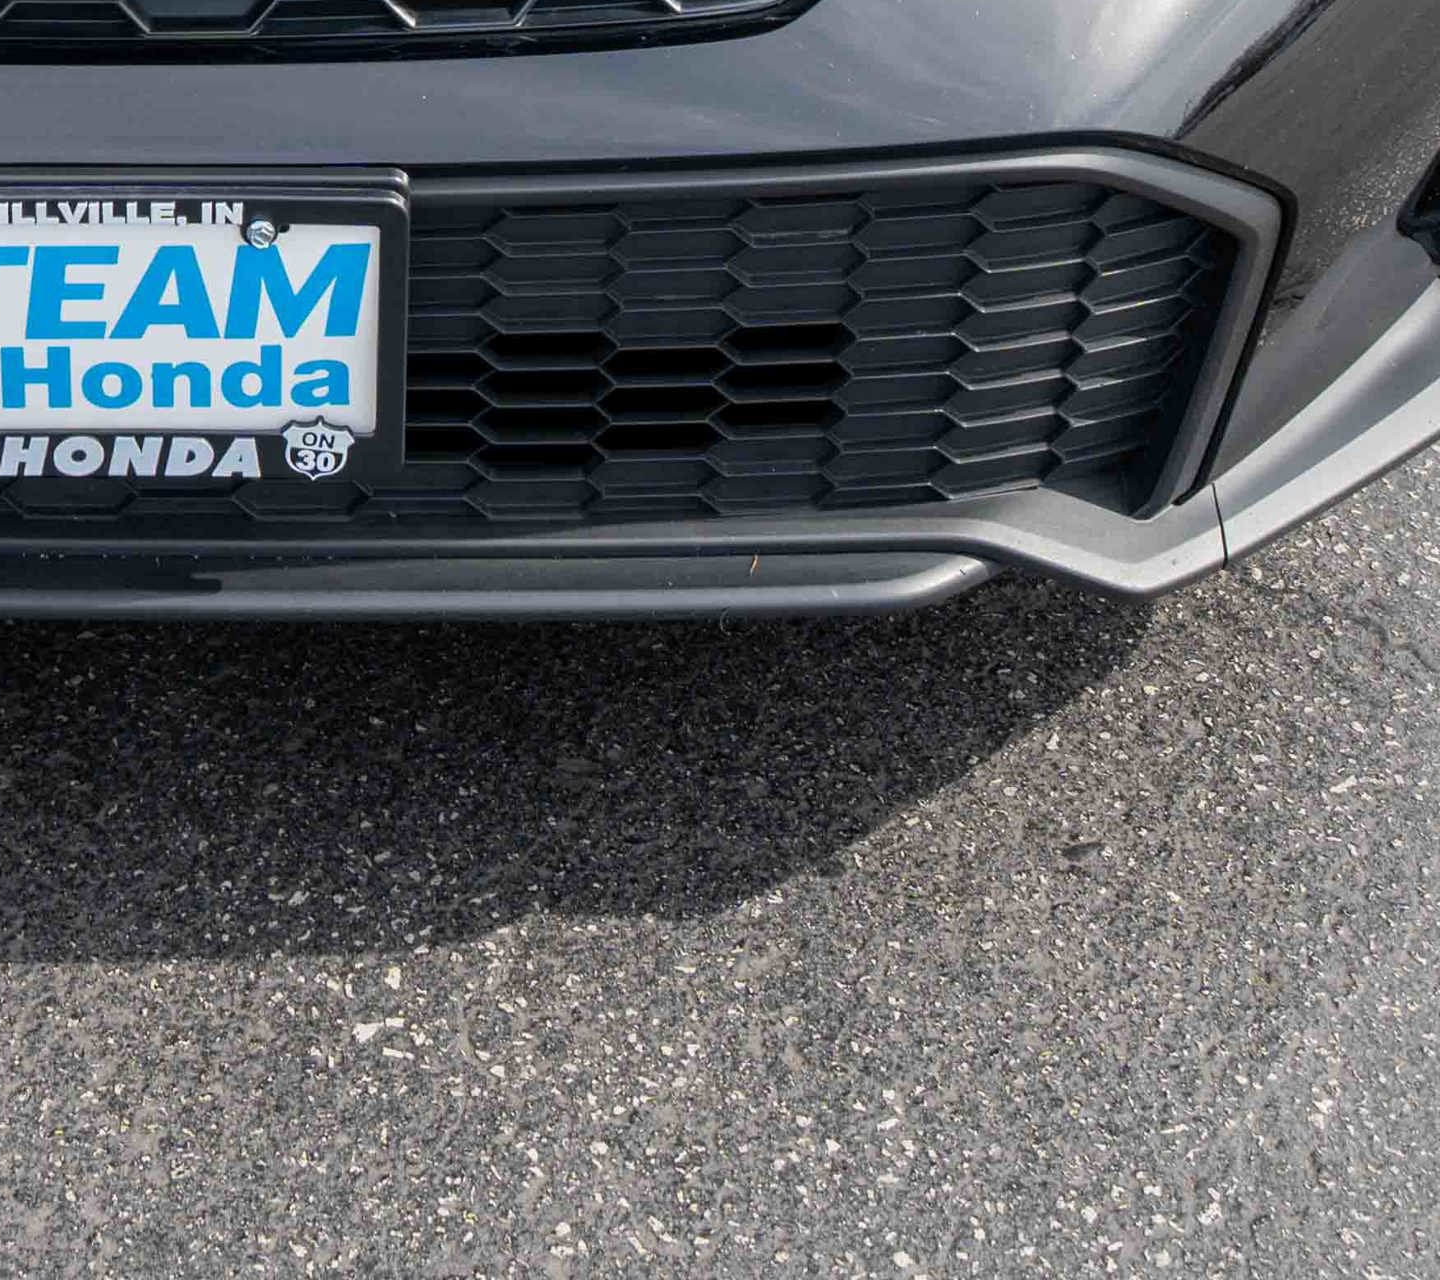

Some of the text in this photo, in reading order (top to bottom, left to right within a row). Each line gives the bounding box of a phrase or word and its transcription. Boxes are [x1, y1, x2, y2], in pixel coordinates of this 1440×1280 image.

[201, 201, 244, 225] IN
[0, 344, 351, 409] Honda
[301, 431, 336, 450] ON
[295, 449, 337, 472] 30
